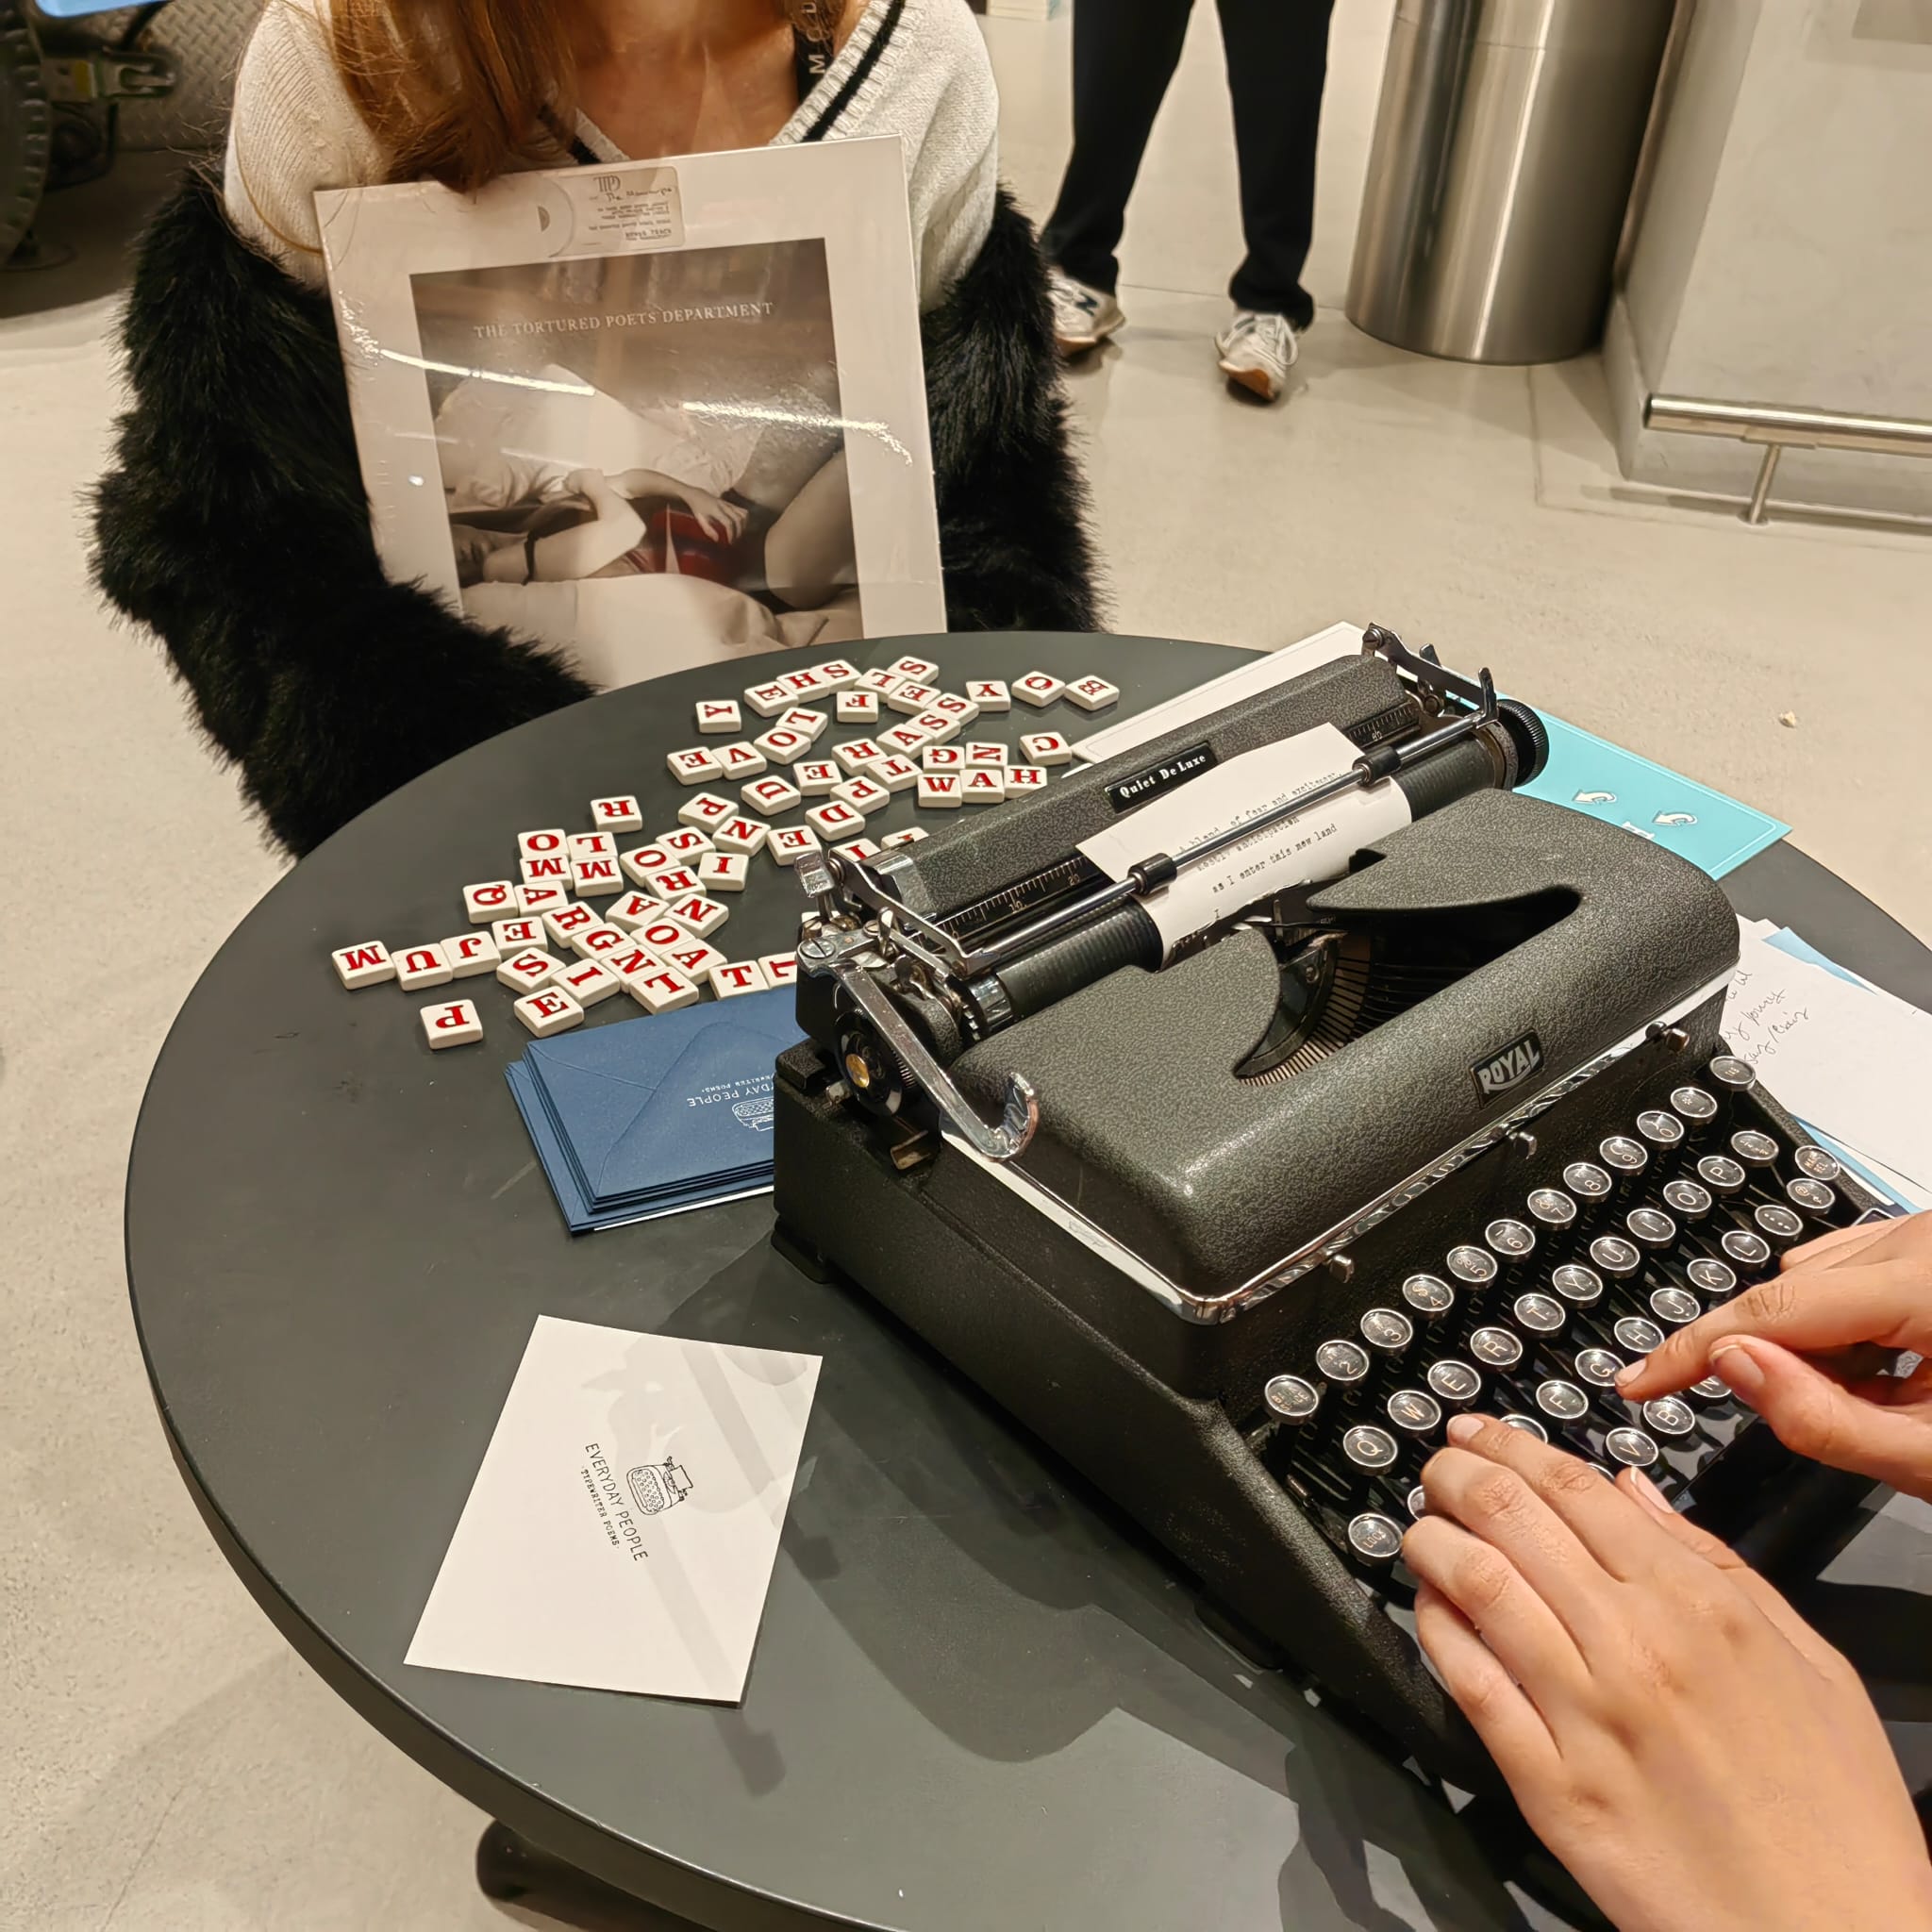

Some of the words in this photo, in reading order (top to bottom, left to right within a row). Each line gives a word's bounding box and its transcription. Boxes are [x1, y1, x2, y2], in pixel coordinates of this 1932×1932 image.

[474, 325, 508, 339] THE
[512, 317, 601, 335] TORTURED
[606, 311, 658, 327] POETS
[662, 301, 774, 324] DEPARTMENT
[1119, 774, 1157, 799] Quiet
[1230, 815, 1243, 827] of
[1212, 882, 1224, 894] as
[1226, 874, 1236, 887] I
[1239, 859, 1266, 880] enter
[1268, 845, 1293, 865] this
[1295, 836, 1312, 852] new
[1313, 823, 1339, 845] land
[1477, 1040, 1541, 1094] ROYAL
[687, 1089, 741, 1107] PEOPLE
[1708, 1165, 1727, 1180] P
[1602, 1248, 1625, 1264] U
[1734, 1244, 1757, 1257] L
[1565, 1275, 1588, 1292] Y
[1699, 1269, 1724, 1287] K
[1525, 1305, 1549, 1322] T
[1667, 1300, 1685, 1315] J
[1625, 1328, 1651, 1347] H
[1481, 1340, 1507, 1358] R
[1589, 1361, 1614, 1378] G
[1441, 1373, 1468, 1392] E
[1549, 1391, 1569, 1412] F
[1401, 1402, 1425, 1421] W
[1655, 1408, 1680, 1427] B
[1356, 1440, 1384, 1457] Q
[1618, 1440, 1641, 1457] V
[585, 1442, 625, 1507] EVERYDAY
[615, 1510, 648, 1561] PEOPLE
